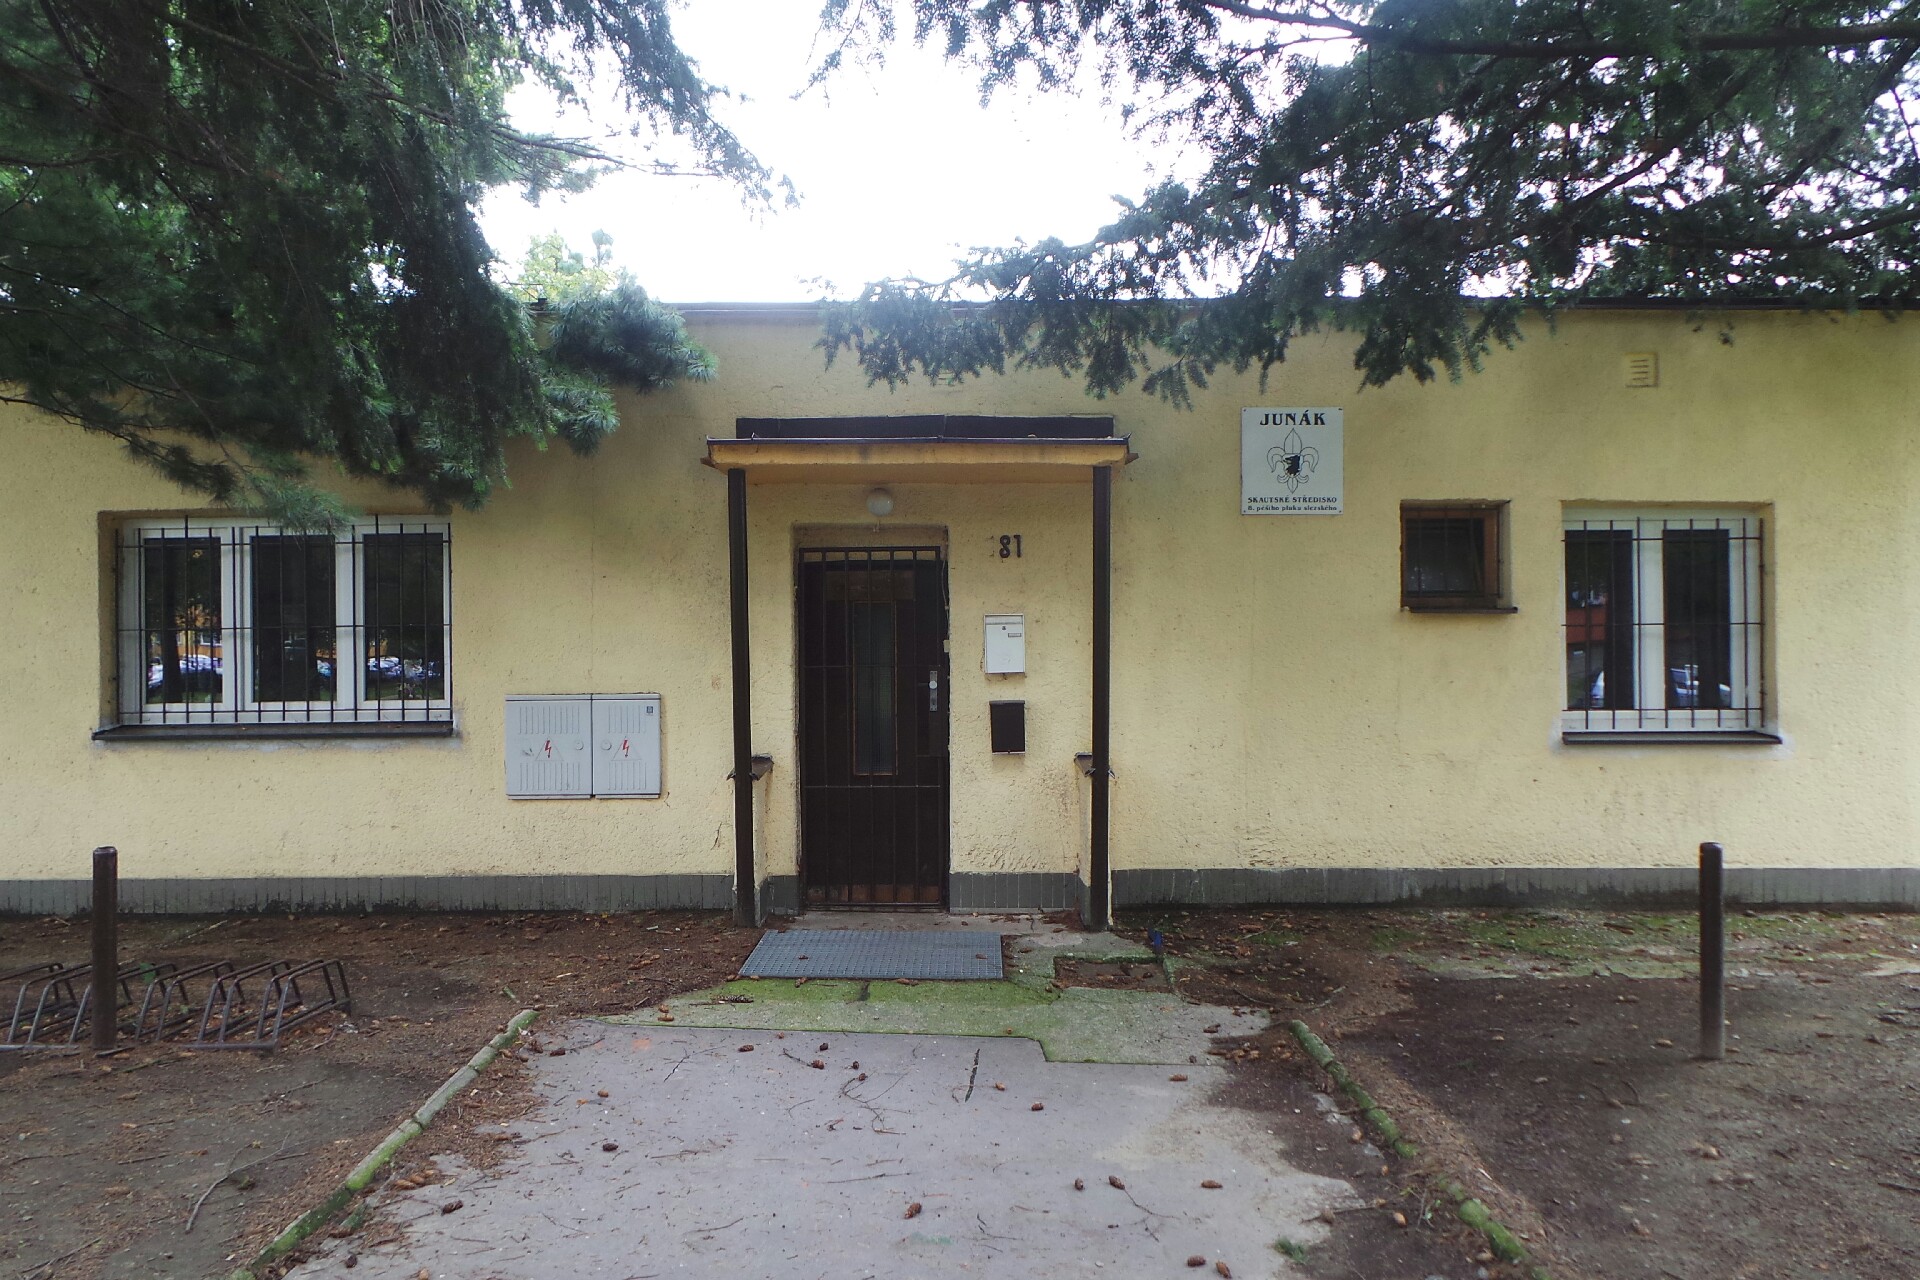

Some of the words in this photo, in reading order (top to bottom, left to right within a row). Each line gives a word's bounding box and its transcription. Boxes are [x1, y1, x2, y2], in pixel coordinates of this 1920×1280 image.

[1260, 409, 1326, 426] JUNÁK
[1247, 494, 1290, 503] SKAUTSKÉ
[1292, 494, 1337, 503] STŘEDISKO
[999, 534, 1022, 559] 81
